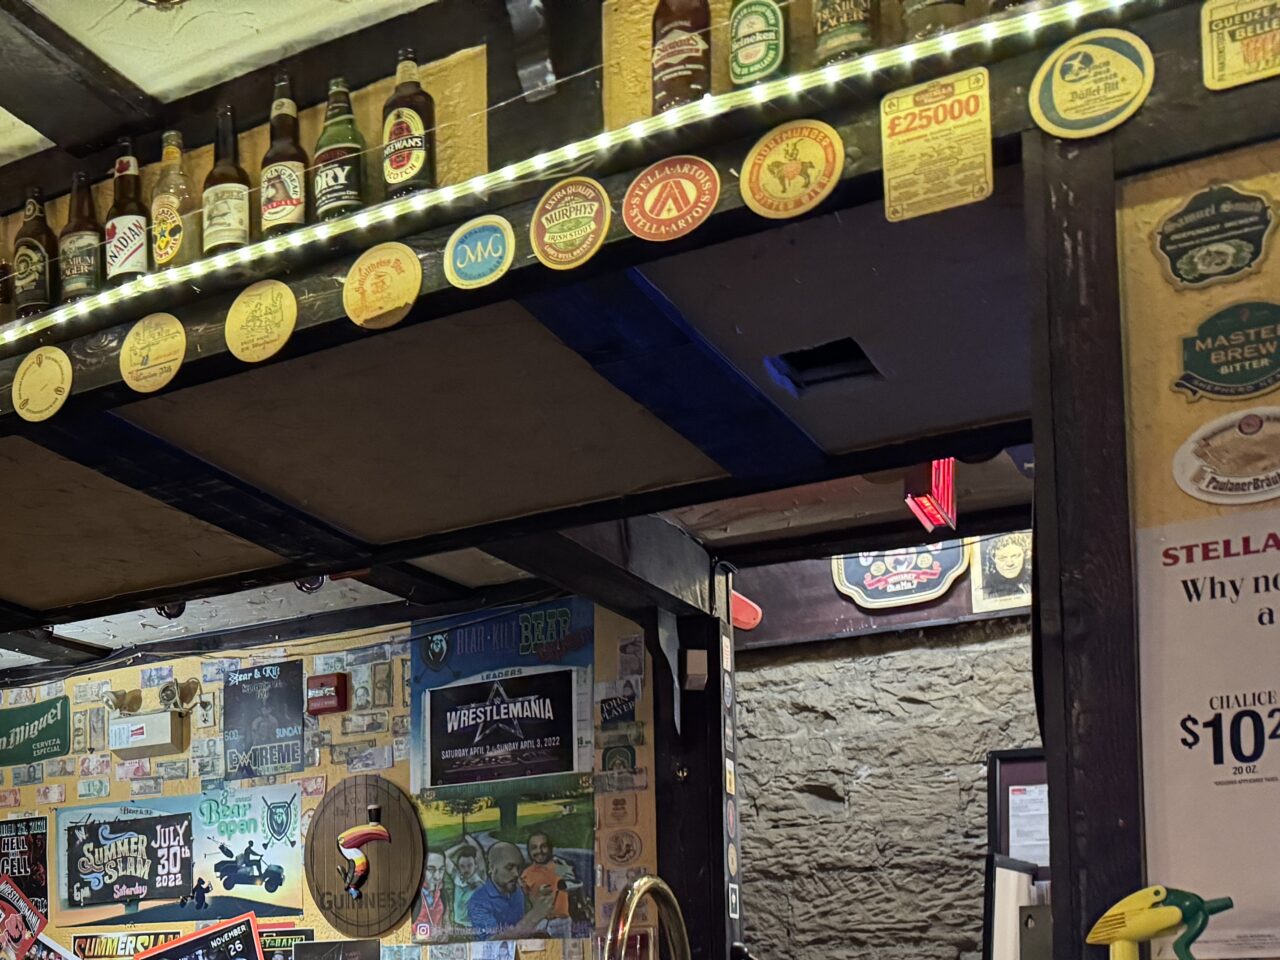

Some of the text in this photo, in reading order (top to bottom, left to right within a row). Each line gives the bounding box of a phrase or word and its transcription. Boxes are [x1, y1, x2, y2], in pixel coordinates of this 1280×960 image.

[1211, 10, 1269, 31] GUEUZE
[887, 94, 980, 139] £25000
[631, 163, 712, 204] STELLA ARTOIS
[545, 184, 596, 210] EXTRA QUALITY
[630, 195, 711, 234] STELLA ARTOIS
[568, 224, 593, 239] STOUT
[1195, 325, 1280, 351] MASTE
[1210, 341, 1279, 364] BREW
[1220, 357, 1269, 374] BITTER
[1162, 532, 1280, 567] STELLA
[1181, 575, 1244, 603] Why
[1257, 607, 1275, 626] a
[481, 668, 523, 680] LEADERS
[602, 696, 629, 712] JOHN
[1209, 690, 1277, 710] CHALICE
[7, 699, 62, 749] Miguel
[446, 698, 554, 733] WRESTLEMANIA
[275, 727, 303, 738] SUNDAY
[32, 738, 61, 750] CERVEZA
[33, 746, 61, 757] ESPECIAL
[441, 748, 468, 760] SATURDAY
[469, 746, 485, 757] APRIL
[496, 743, 519, 754] SUNDAY
[520, 740, 535, 751] APRIL
[544, 737, 560, 748] 2022
[227, 740, 300, 773] EXTREME
[1232, 766, 1244, 775] 20
[201, 799, 251, 827] Bear
[151, 820, 189, 848] JULY
[217, 817, 258, 839] open
[1, 836, 28, 853] HELL
[83, 835, 148, 867] SUMMER
[0, 856, 31, 877] CELL
[104, 858, 152, 883] SLAM
[157, 846, 191, 875] 30th
[113, 883, 148, 899] Saturday
[155, 874, 183, 888] 2022
[321, 891, 406, 911] GUINNESS
[211, 924, 247, 948] NOVEMBER
[227, 940, 243, 957] 26
